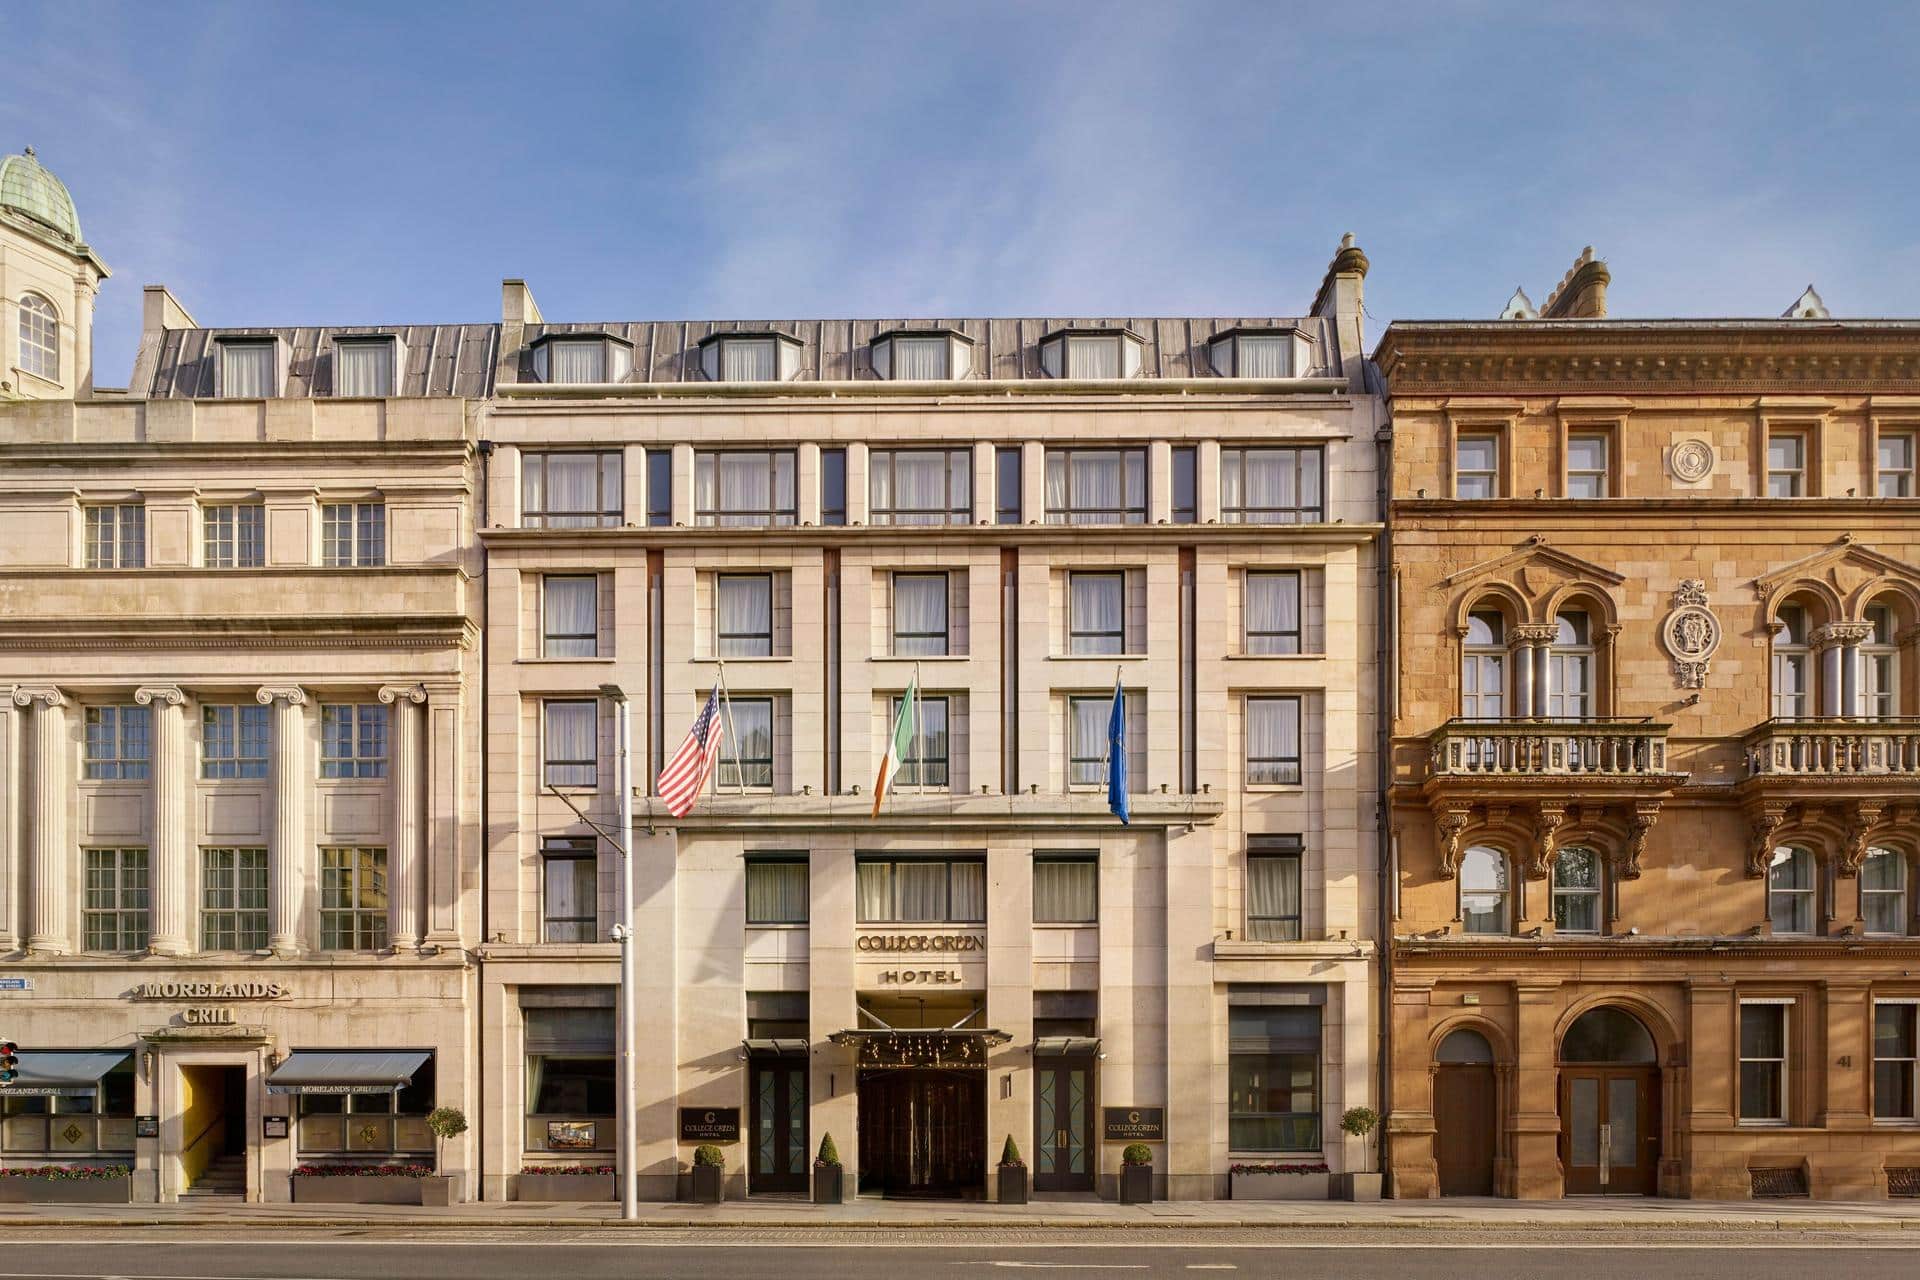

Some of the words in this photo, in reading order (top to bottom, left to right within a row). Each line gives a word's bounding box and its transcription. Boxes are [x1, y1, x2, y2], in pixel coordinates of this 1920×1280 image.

[857, 935, 929, 951] COLLEGE
[932, 935, 984, 951] GREEN
[885, 970, 962, 983] HOTEL
[142, 983, 281, 998] MORELANDS
[182, 1007, 236, 1024] GRILL
[1837, 1055, 1851, 1068] 41
[301, 1085, 351, 1093] MORELANDS
